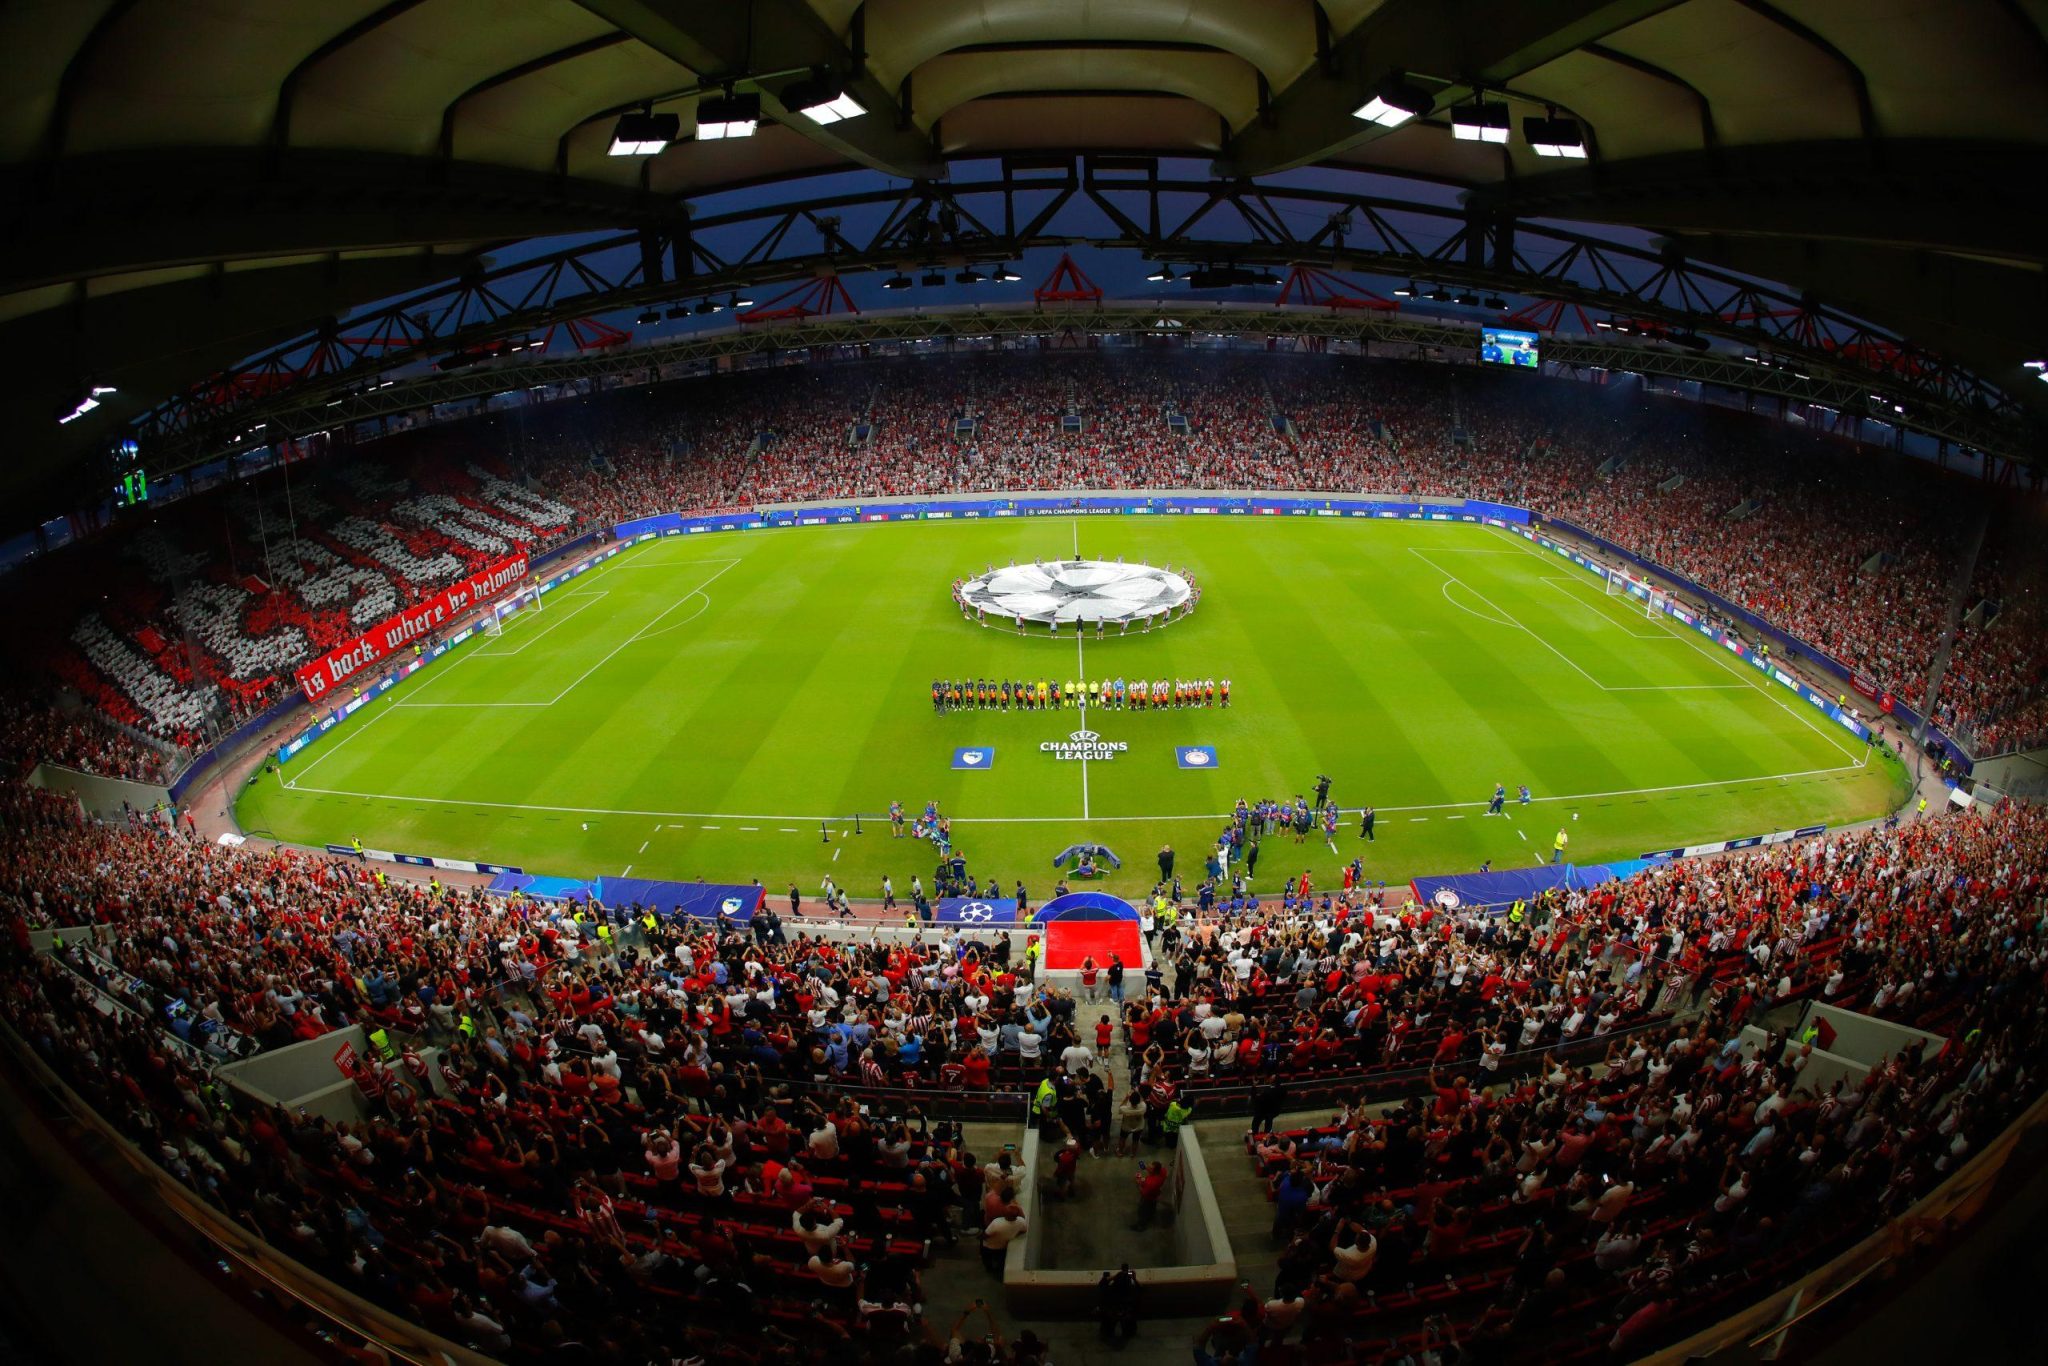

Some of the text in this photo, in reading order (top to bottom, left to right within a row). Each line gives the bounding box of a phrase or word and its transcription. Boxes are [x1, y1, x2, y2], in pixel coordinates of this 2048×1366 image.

[300, 671, 325, 698] is
[385, 605, 444, 648] where
[471, 558, 525, 600] belongs
[1752, 656, 1765, 669] UEFA
[380, 678, 393, 690] UEFA
[1809, 692, 1824, 709] UEFA
[320, 716, 336, 731] UEFA
[1040, 742, 1127, 750] CHAMPIONS
[1056, 751, 1113, 760] LEAGUE
